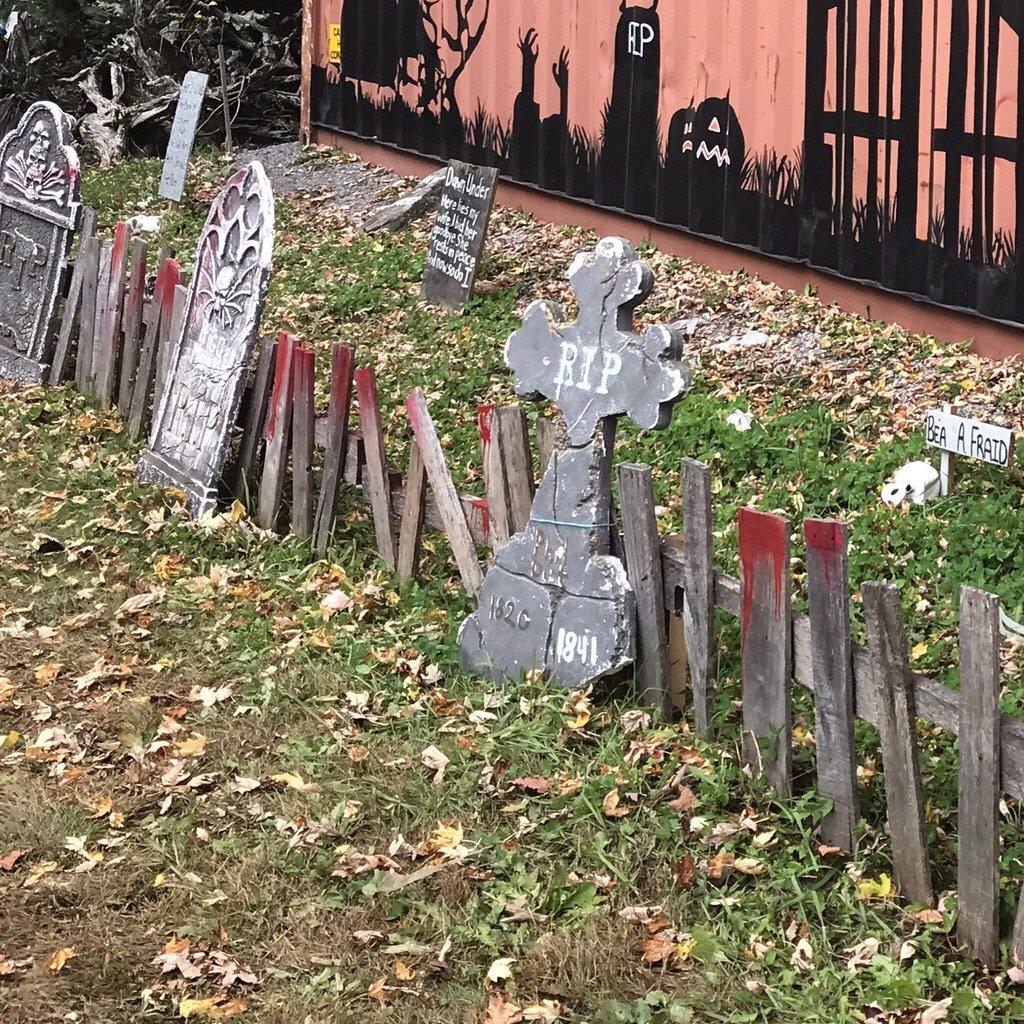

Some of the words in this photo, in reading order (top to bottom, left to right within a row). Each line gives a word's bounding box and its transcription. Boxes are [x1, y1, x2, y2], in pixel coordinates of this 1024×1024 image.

[466, 173, 490, 199] Under
[441, 193, 457, 210] Here
[457, 197, 469, 215] lies
[469, 208, 480, 226] my
[456, 233, 469, 251] She
[465, 220, 478, 241] her
[454, 249, 476, 267] peace
[461, 267, 472, 288] I
[554, 341, 622, 394] RIP
[556, 627, 600, 666] 1841
